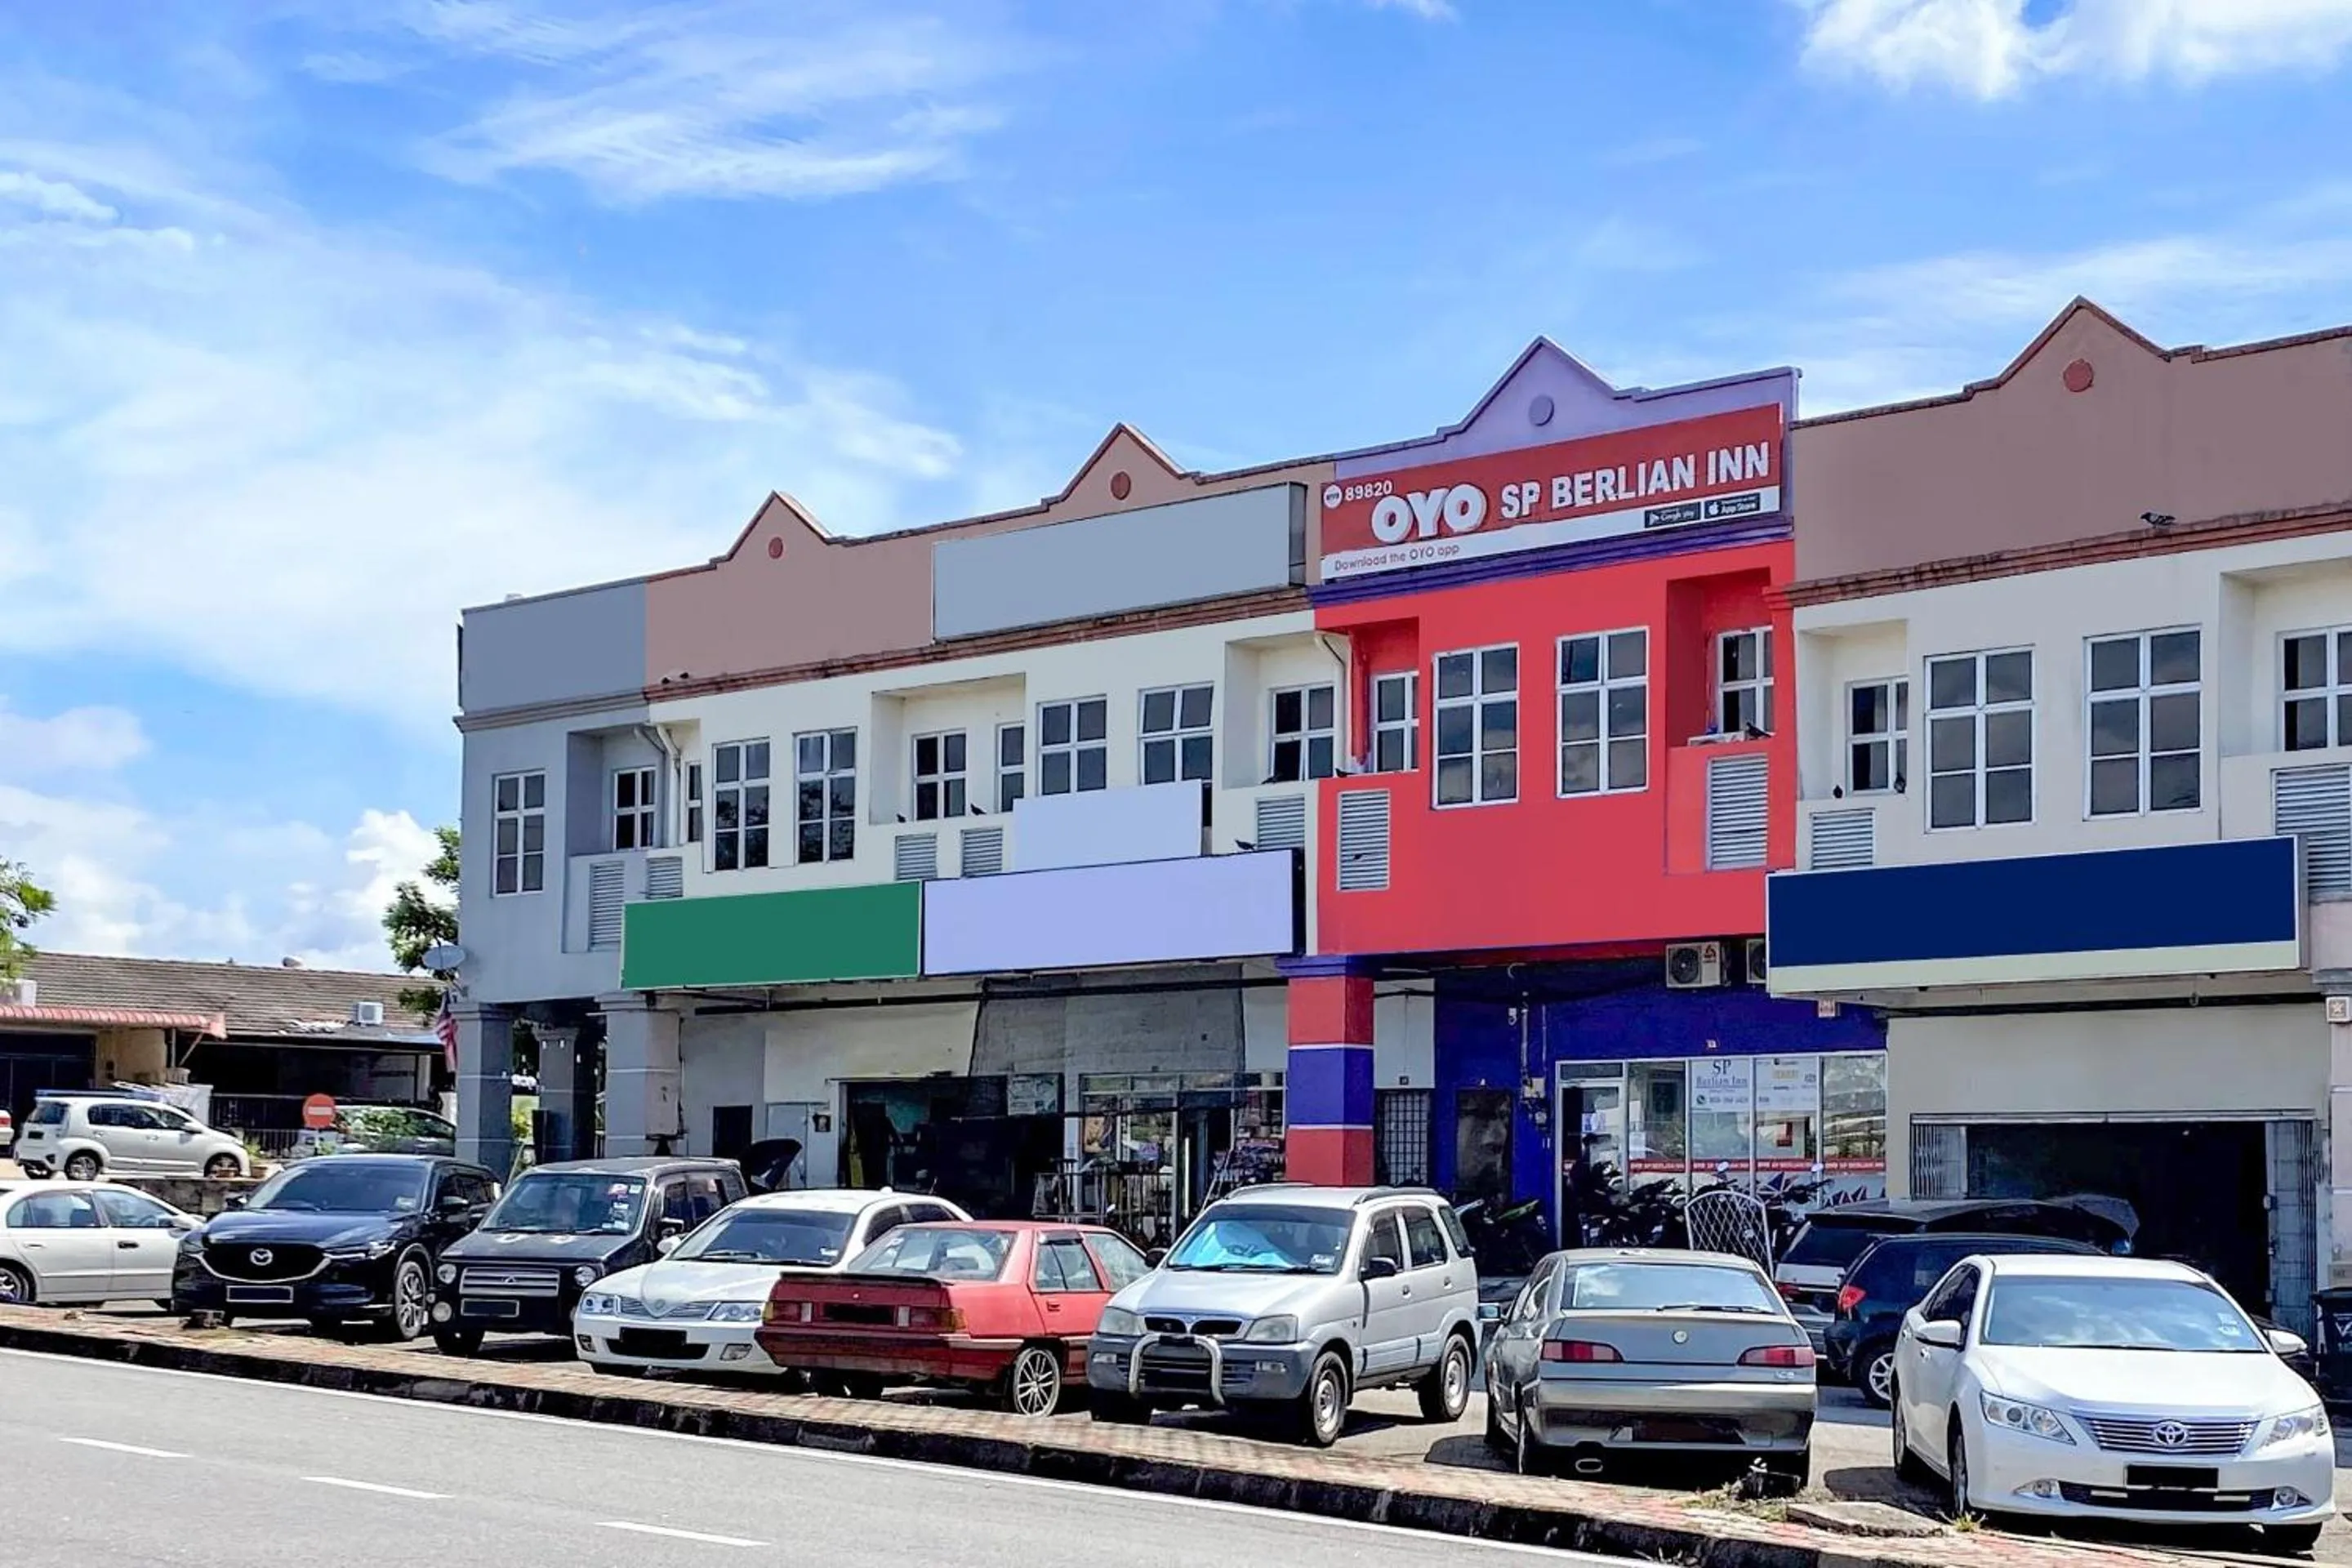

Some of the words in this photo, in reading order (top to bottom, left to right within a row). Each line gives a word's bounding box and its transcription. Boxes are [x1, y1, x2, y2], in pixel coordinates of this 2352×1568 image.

[1344, 479, 1393, 502] 89820
[1500, 480, 1541, 519] SP
[1552, 453, 1696, 510] BERLIAN
[1707, 441, 1769, 486] INN
[1370, 483, 1488, 544] OYO
[1334, 552, 1388, 571] Download
[1389, 550, 1406, 564] the
[1409, 545, 1435, 561] OYO
[1437, 544, 1460, 558] app
[1712, 1058, 1732, 1076] SP
